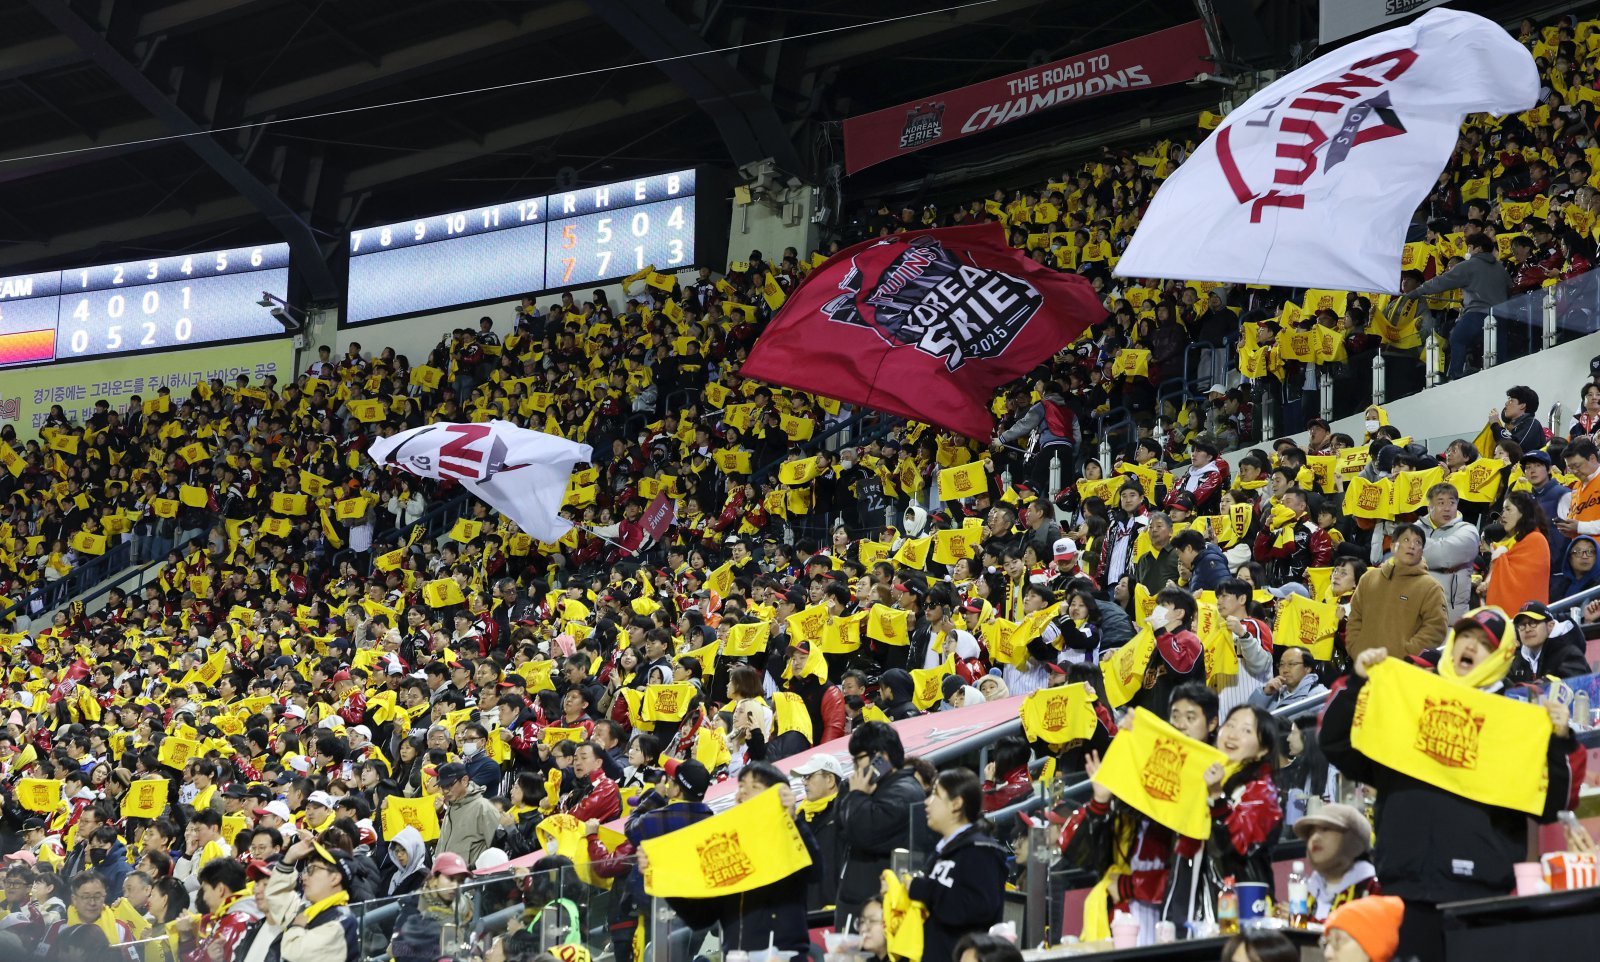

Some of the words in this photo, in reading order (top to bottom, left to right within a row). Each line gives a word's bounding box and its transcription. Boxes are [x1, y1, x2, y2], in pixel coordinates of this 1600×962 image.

[1007, 75, 1039, 96] THE
[1042, 61, 1085, 86] ROAD
[1088, 54, 1110, 73] TO
[960, 64, 1152, 134] CHAMPIONS
[900, 127, 942, 148] SERIES
[905, 121, 939, 135] KOREAN
[1337, 102, 1370, 145] SEO
[352, 234, 363, 251] 7
[380, 228, 392, 246] 8
[414, 222, 426, 240] 9
[446, 214, 466, 234] 10
[482, 208, 500, 228] 11
[518, 202, 538, 222] 12
[563, 194, 576, 213] R
[596, 188, 609, 207] H
[635, 181, 646, 200] E
[667, 175, 680, 194] B
[561, 225, 577, 249] 5
[597, 218, 613, 243] 5
[632, 212, 649, 237] 0
[667, 206, 685, 230] 4
[0, 277, 33, 299] AM
[80, 270, 88, 288] 1
[113, 266, 124, 284] 2
[147, 262, 158, 279] 3
[181, 257, 193, 275] 4
[216, 253, 228, 271] 5
[251, 249, 263, 267] 6
[561, 258, 576, 282] 7
[597, 251, 612, 276] 7
[634, 247, 644, 269] 1
[668, 239, 684, 264] 3
[867, 247, 937, 304] TWINS
[73, 299, 90, 321] 4
[107, 294, 125, 318] 0
[142, 291, 159, 314] 0
[181, 286, 192, 310] 1
[901, 264, 993, 334] KOREA
[71, 329, 88, 353] 0
[107, 325, 122, 349] 5
[141, 322, 156, 345] 2
[175, 317, 192, 341] 0
[969, 325, 1008, 356] 2025
[34, 386, 87, 405] 경기중에는
[90, 377, 144, 397] 그라운드를
[148, 372, 203, 392] 주시하시고
[0, 397, 21, 421] 의
[1415, 733, 1478, 769] SERIES
[1142, 770, 1181, 802] SERIES
[705, 860, 756, 888] SERIES
